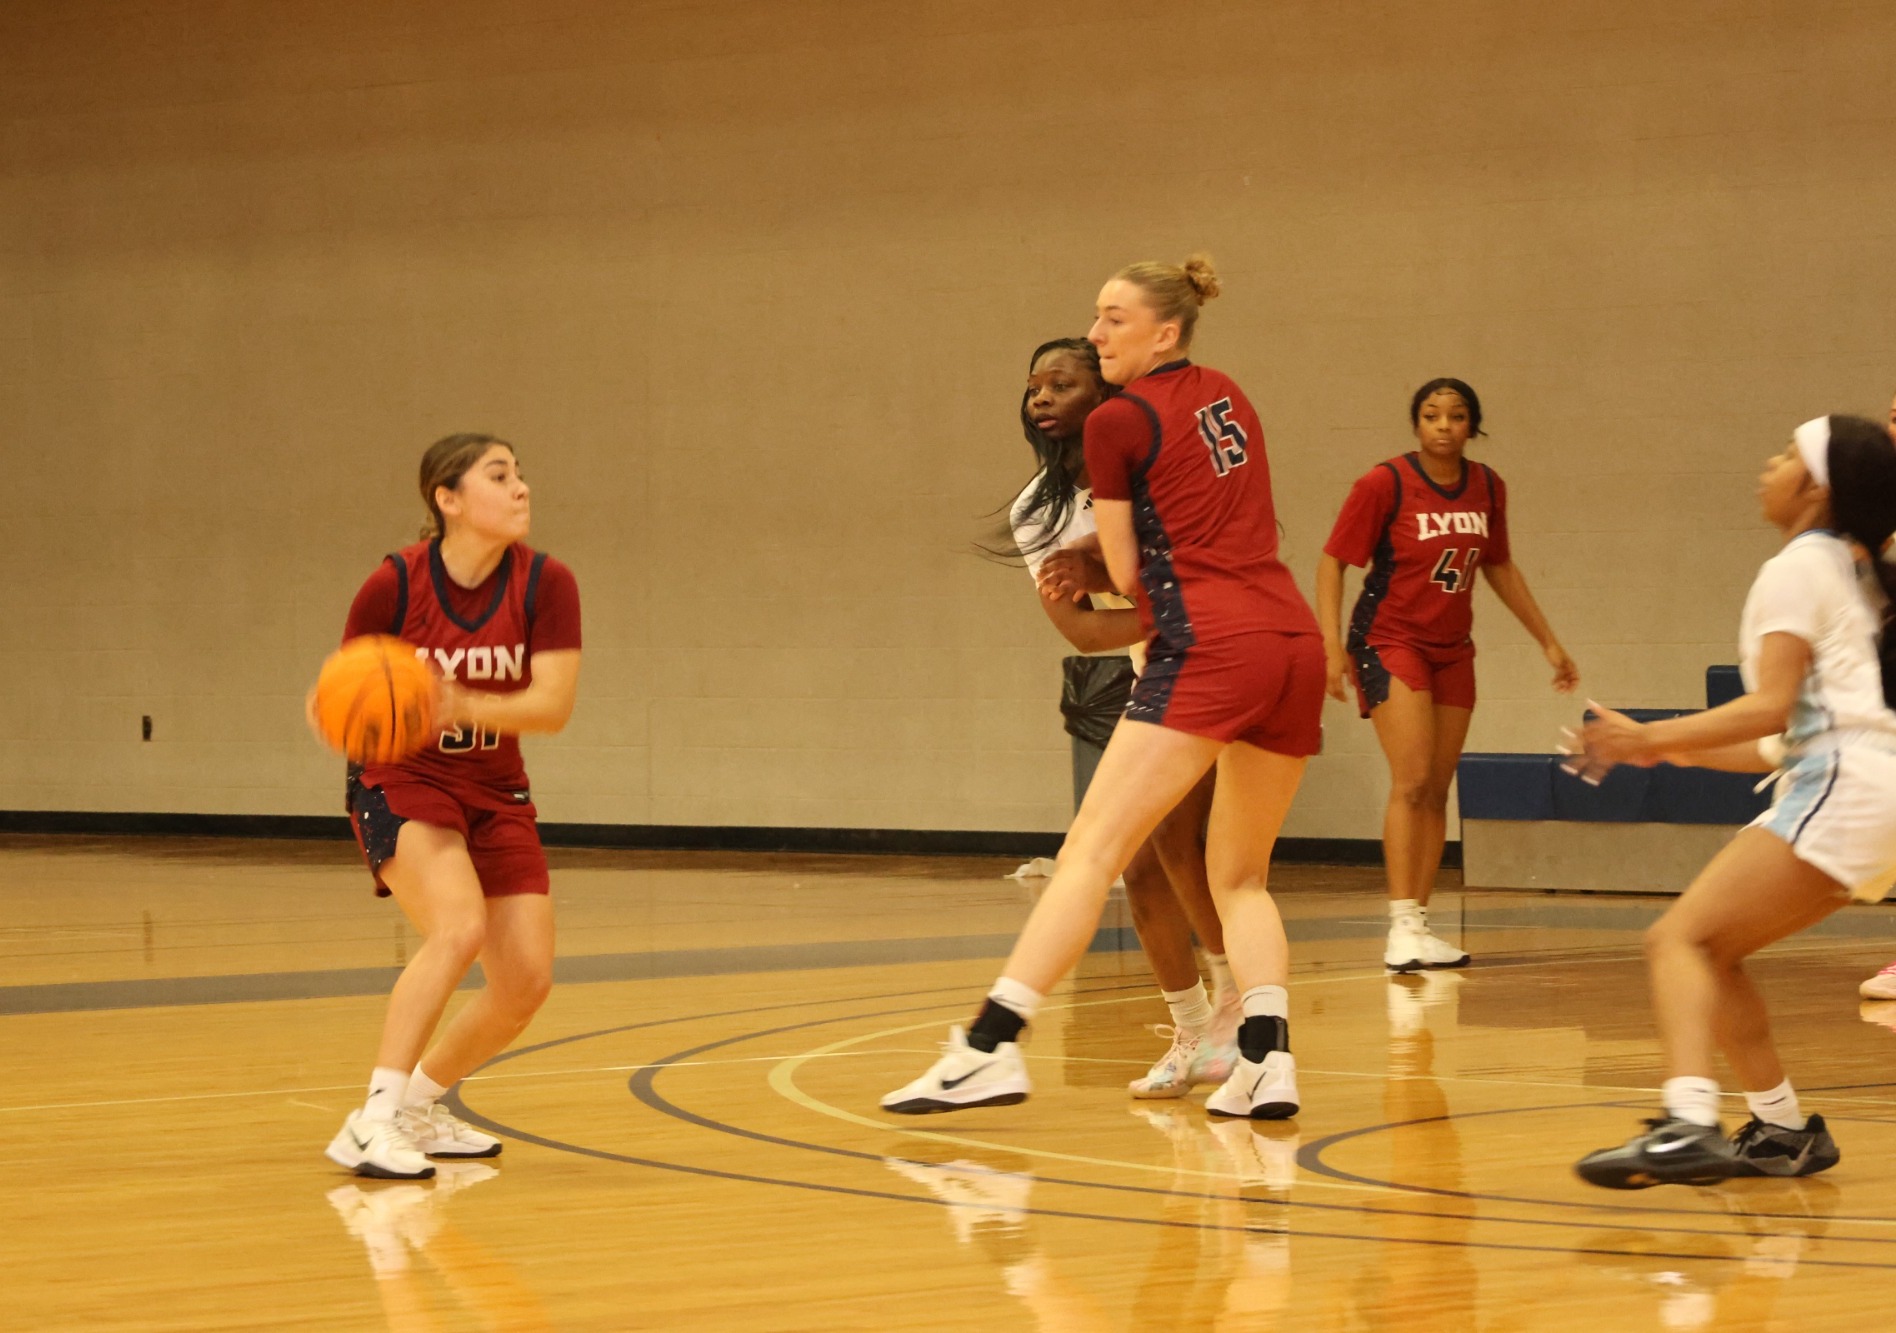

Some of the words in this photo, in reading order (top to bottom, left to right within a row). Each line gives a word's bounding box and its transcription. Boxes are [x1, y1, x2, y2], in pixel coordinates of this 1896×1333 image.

[1194, 396, 1248, 477] 15
[1415, 511, 1489, 541] LYON
[1429, 548, 1480, 593] 41
